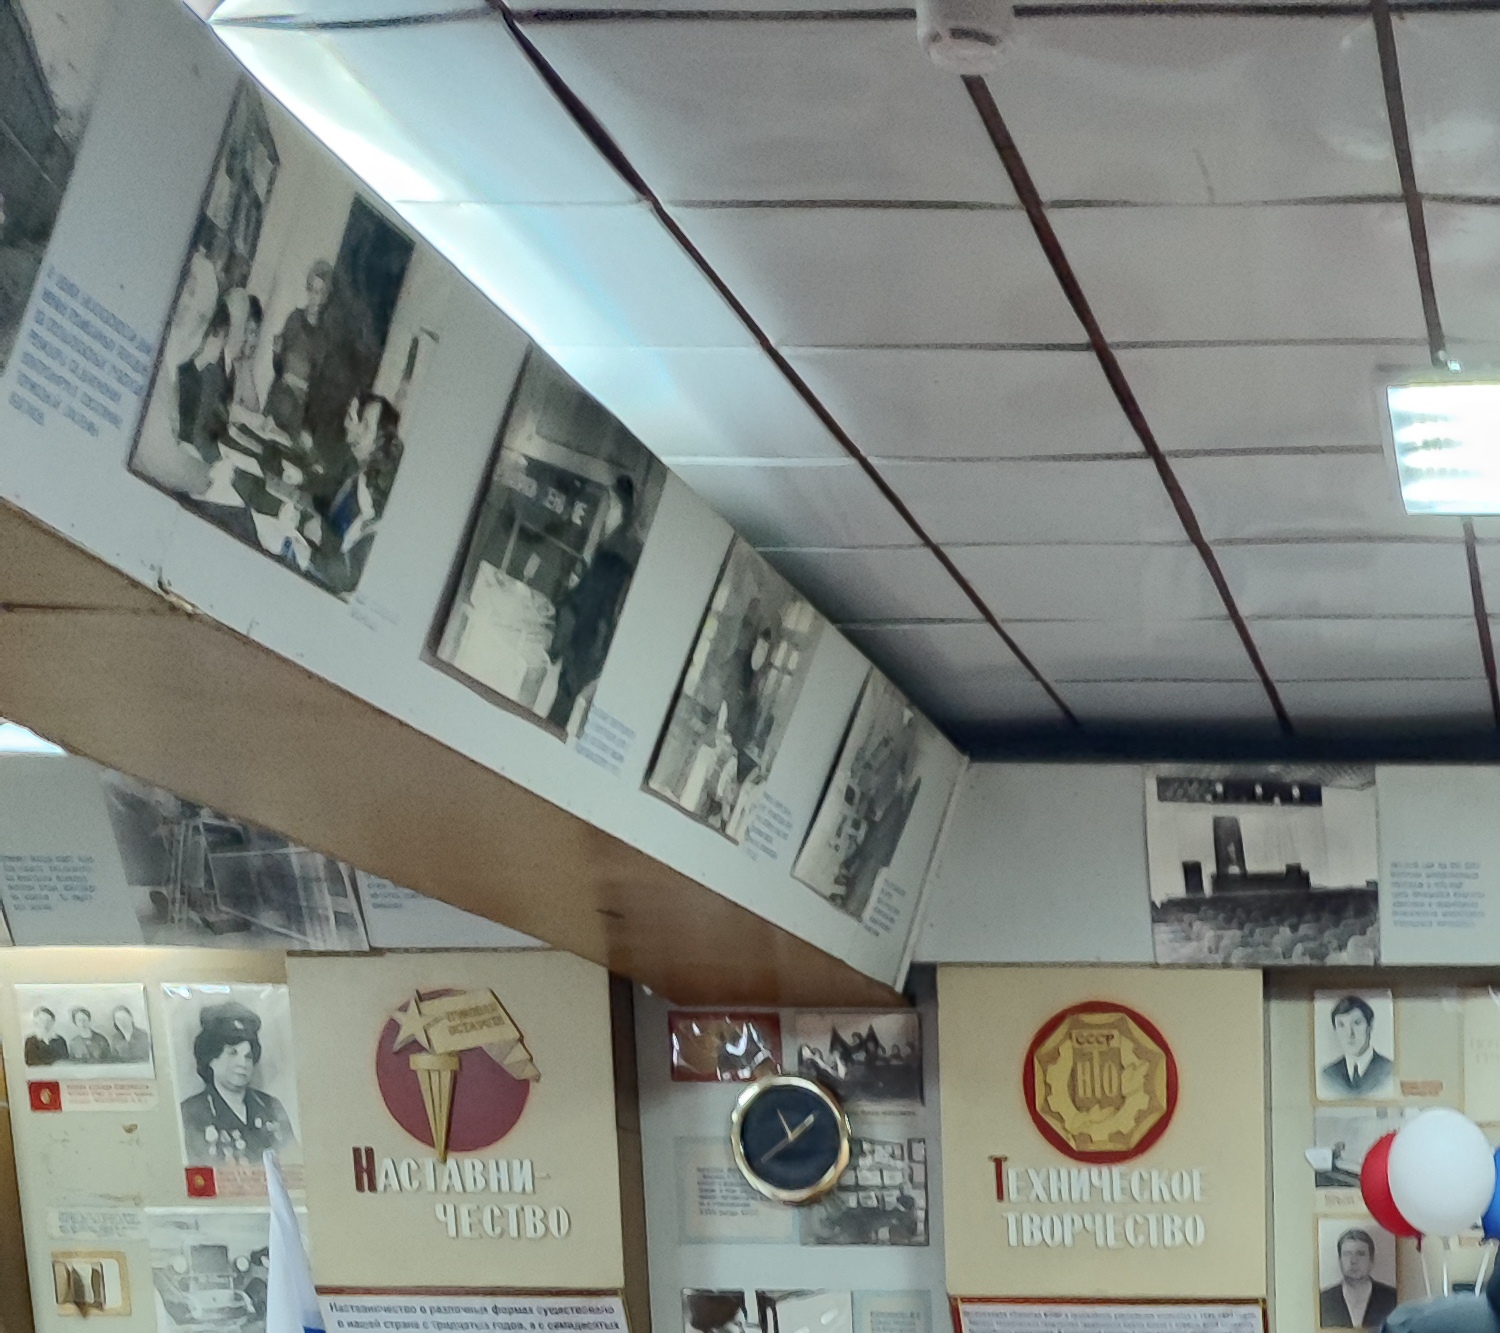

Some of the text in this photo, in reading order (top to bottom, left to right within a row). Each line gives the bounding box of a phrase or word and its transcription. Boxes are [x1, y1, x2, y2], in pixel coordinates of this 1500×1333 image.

[1075, 1033, 1115, 1047] СССР
[1076, 1050, 1120, 1099] НТО
[988, 1154, 1206, 1204] ТЕХНИЧЕСКОЕ
[434, 1202, 572, 1240] ЧЕСТВО
[1002, 1211, 1206, 1249] ТВОРЧЕСТВО
